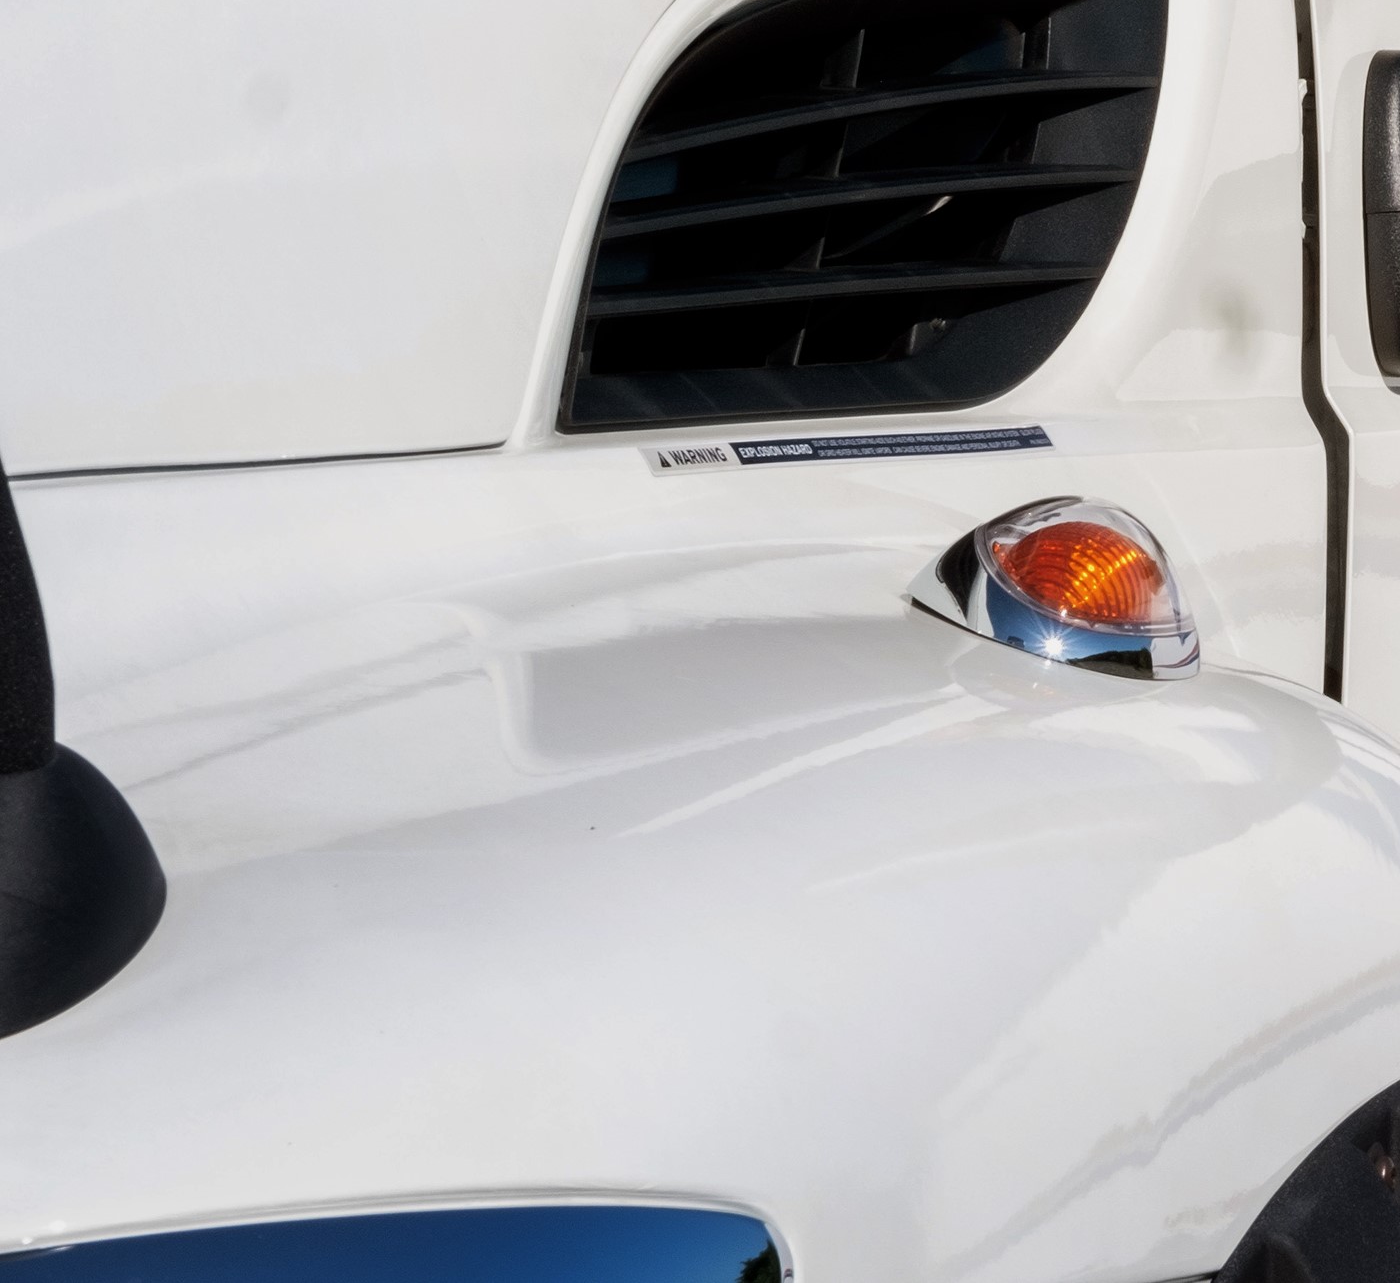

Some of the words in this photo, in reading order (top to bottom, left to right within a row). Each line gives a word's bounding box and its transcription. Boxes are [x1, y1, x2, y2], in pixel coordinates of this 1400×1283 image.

[667, 447, 728, 466] WARNING
[738, 445, 783, 458] EXPLOSION
[783, 444, 813, 456] HAZARD
